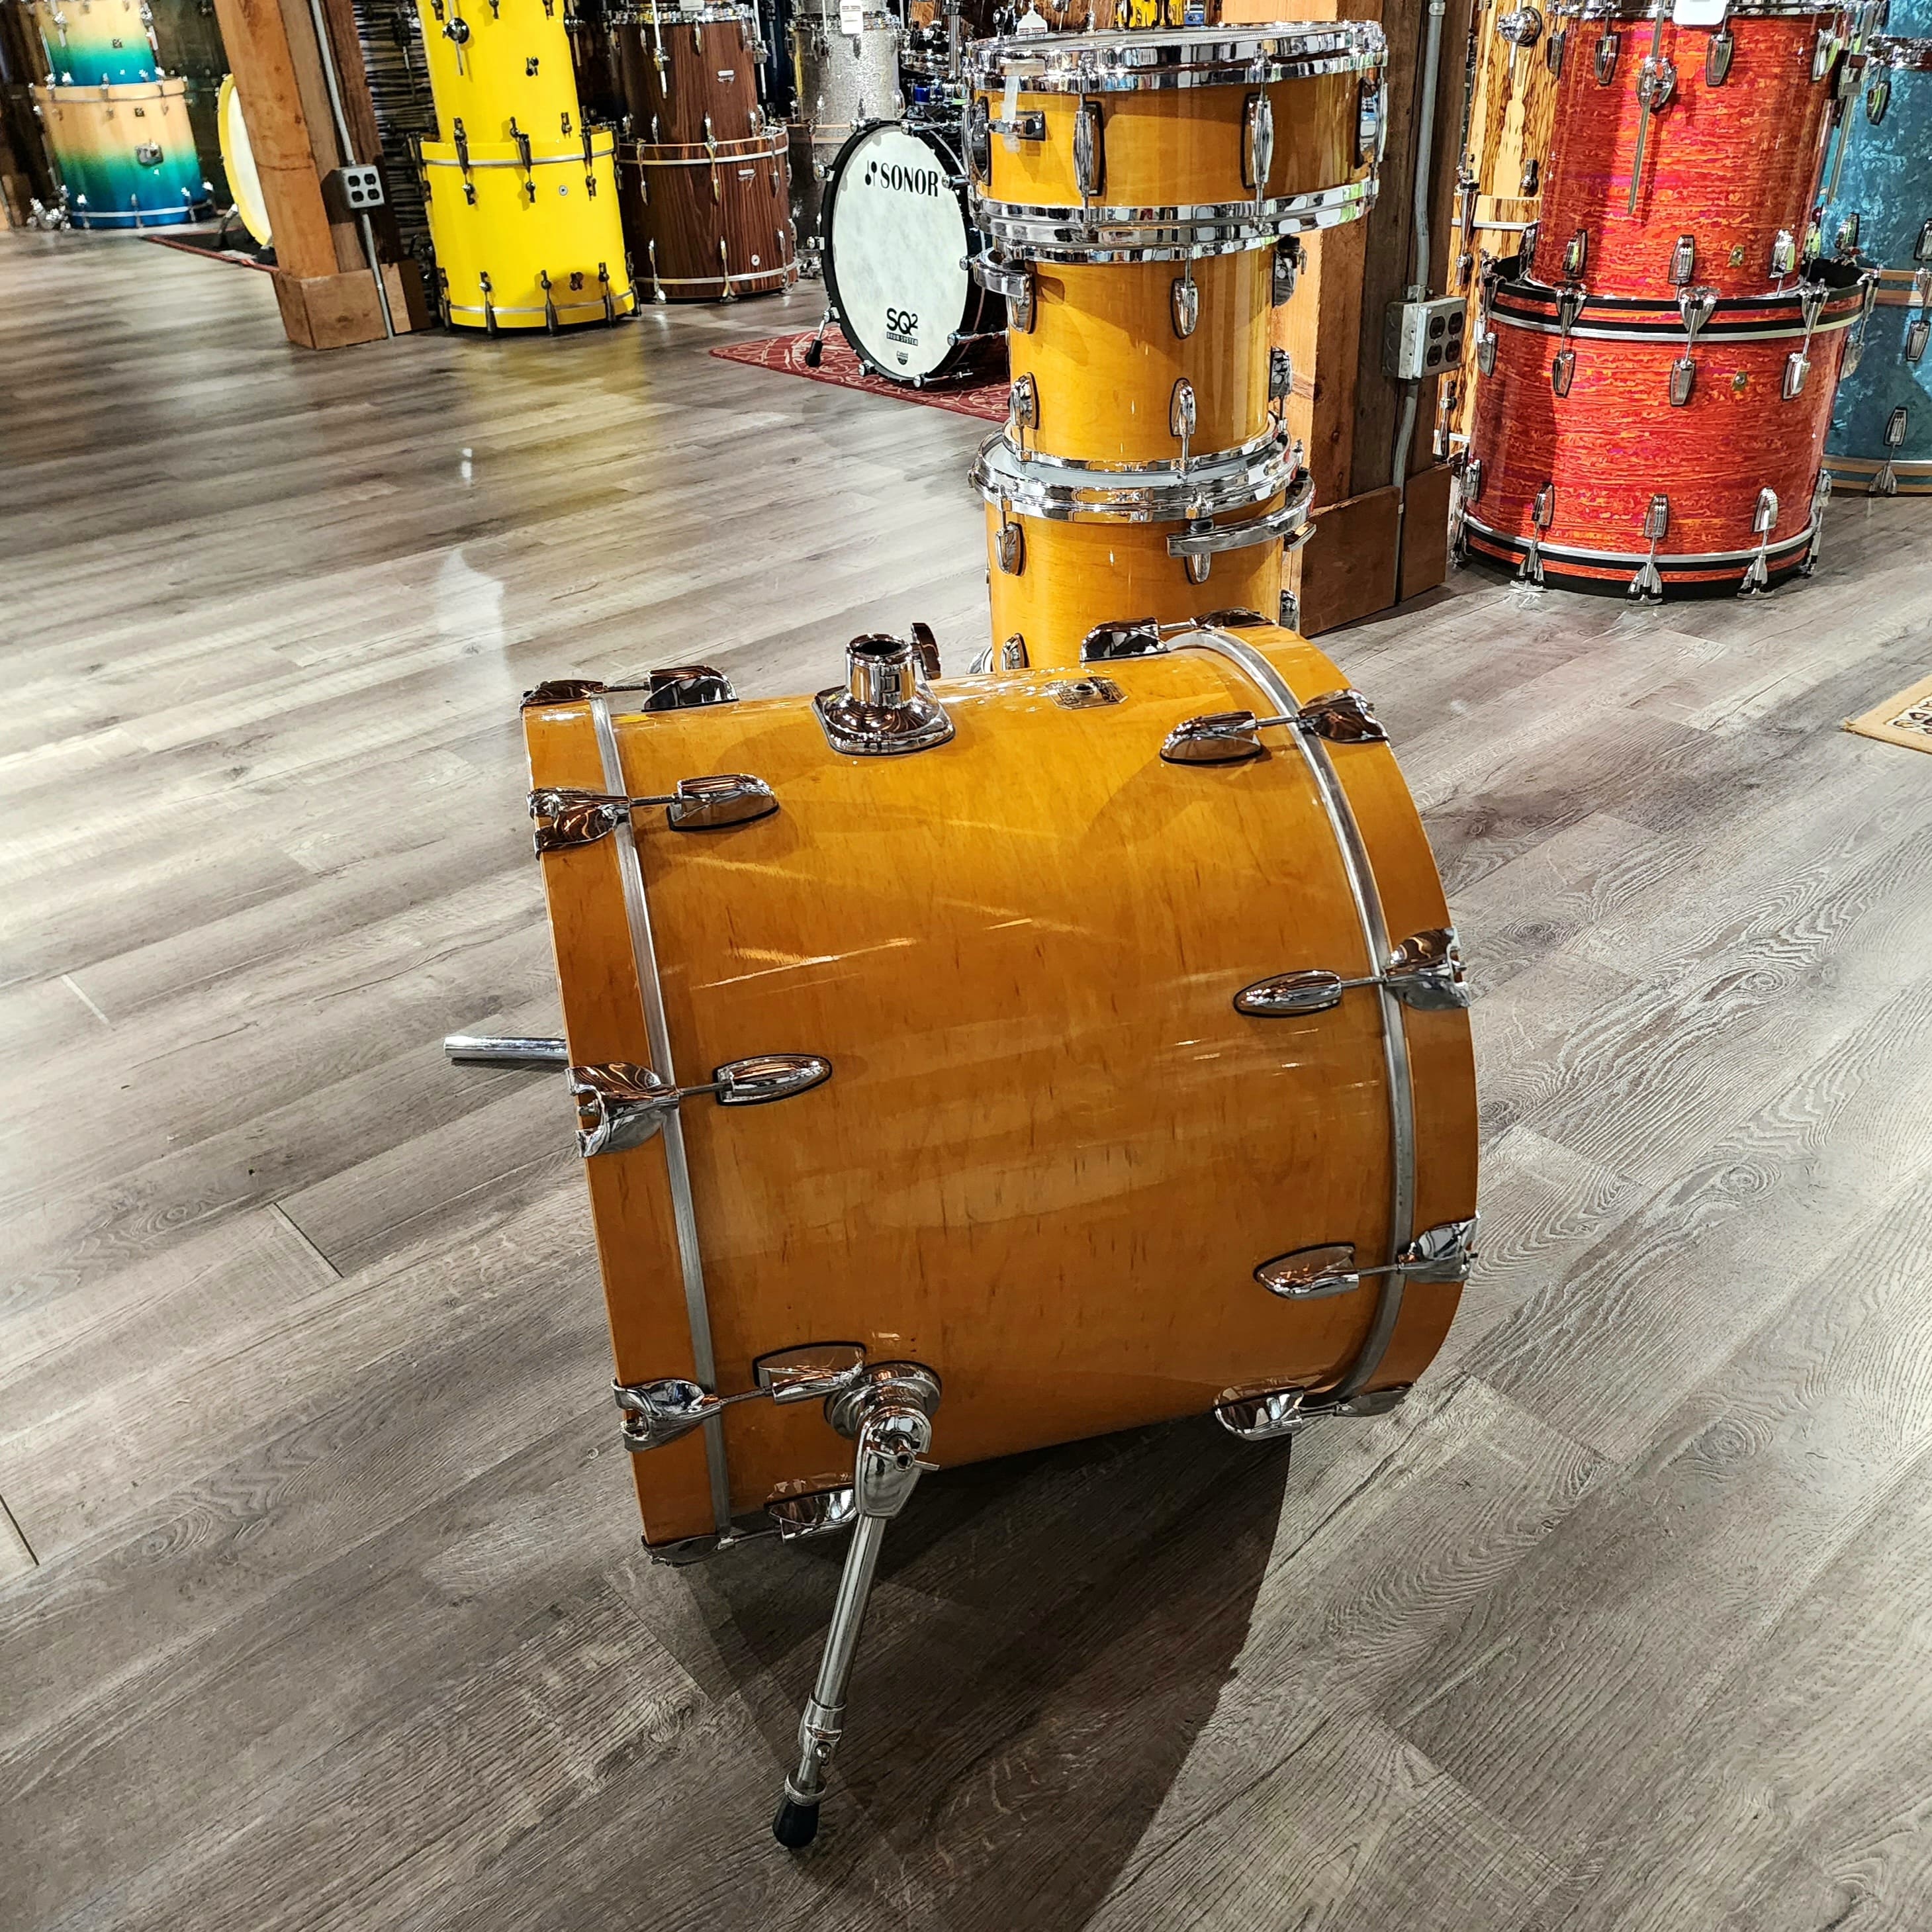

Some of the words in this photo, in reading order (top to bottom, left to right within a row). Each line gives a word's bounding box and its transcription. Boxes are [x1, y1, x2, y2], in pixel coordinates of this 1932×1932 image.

[880, 163, 939, 197] SONOR
[887, 332, 900, 341] DRUM
[900, 336, 918, 345] SYSTEM
